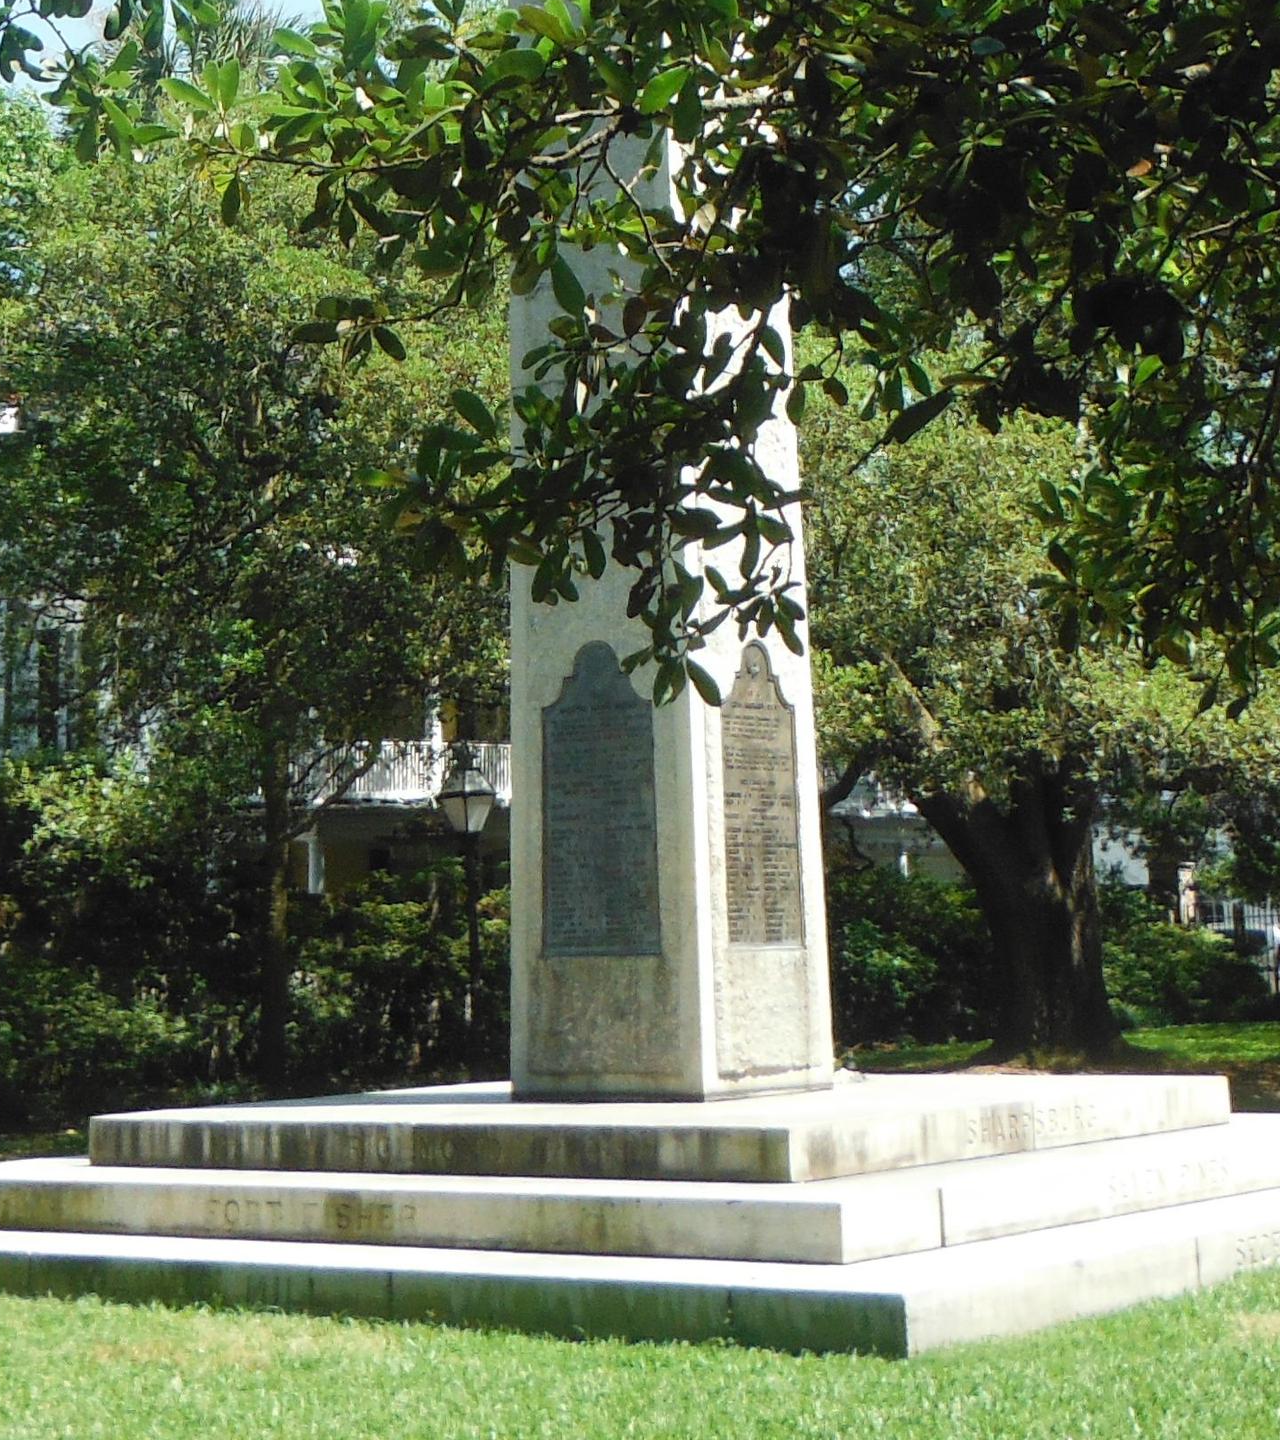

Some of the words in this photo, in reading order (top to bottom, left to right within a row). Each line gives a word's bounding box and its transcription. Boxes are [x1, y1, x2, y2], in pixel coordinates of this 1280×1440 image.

[967, 1103, 1097, 1144] SHARPSBURG
[344, 1133, 501, 1165] RCMOD
[1107, 1167, 1167, 1200] SEVEN
[1179, 1156, 1230, 1189] PINES
[207, 1198, 282, 1231] FORT
[301, 1201, 417, 1234] FISHER
